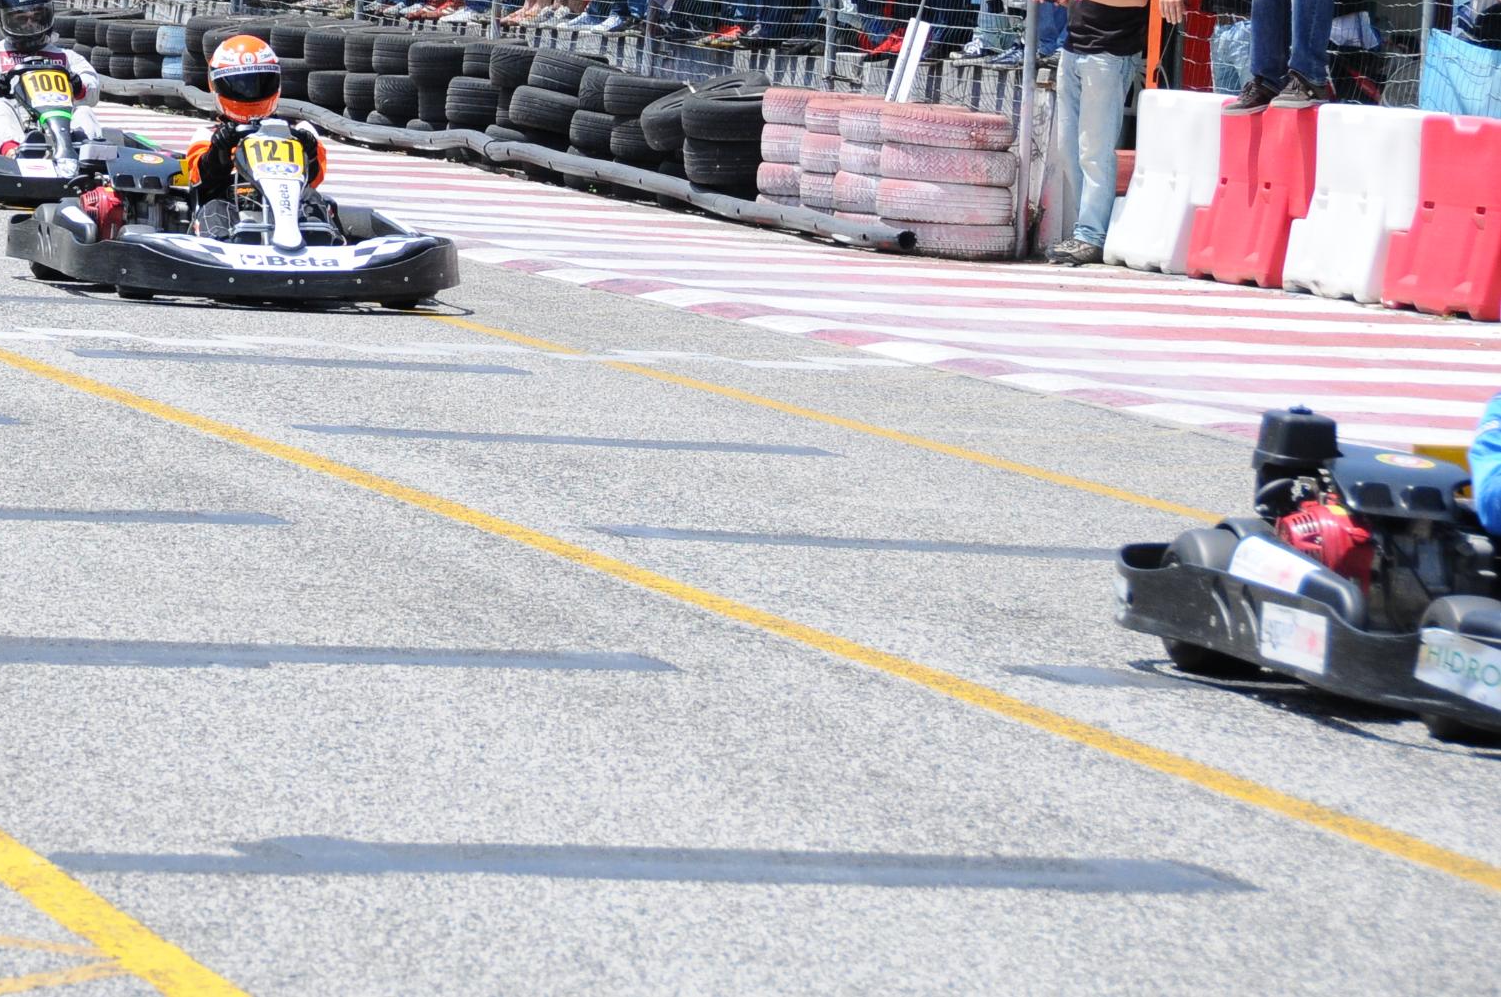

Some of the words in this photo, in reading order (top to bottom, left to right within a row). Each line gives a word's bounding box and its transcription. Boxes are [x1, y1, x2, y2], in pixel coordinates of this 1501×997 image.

[28, 73, 68, 93] 100
[249, 139, 295, 162] 127
[278, 184, 291, 207] Beta
[266, 255, 340, 267] Beta
